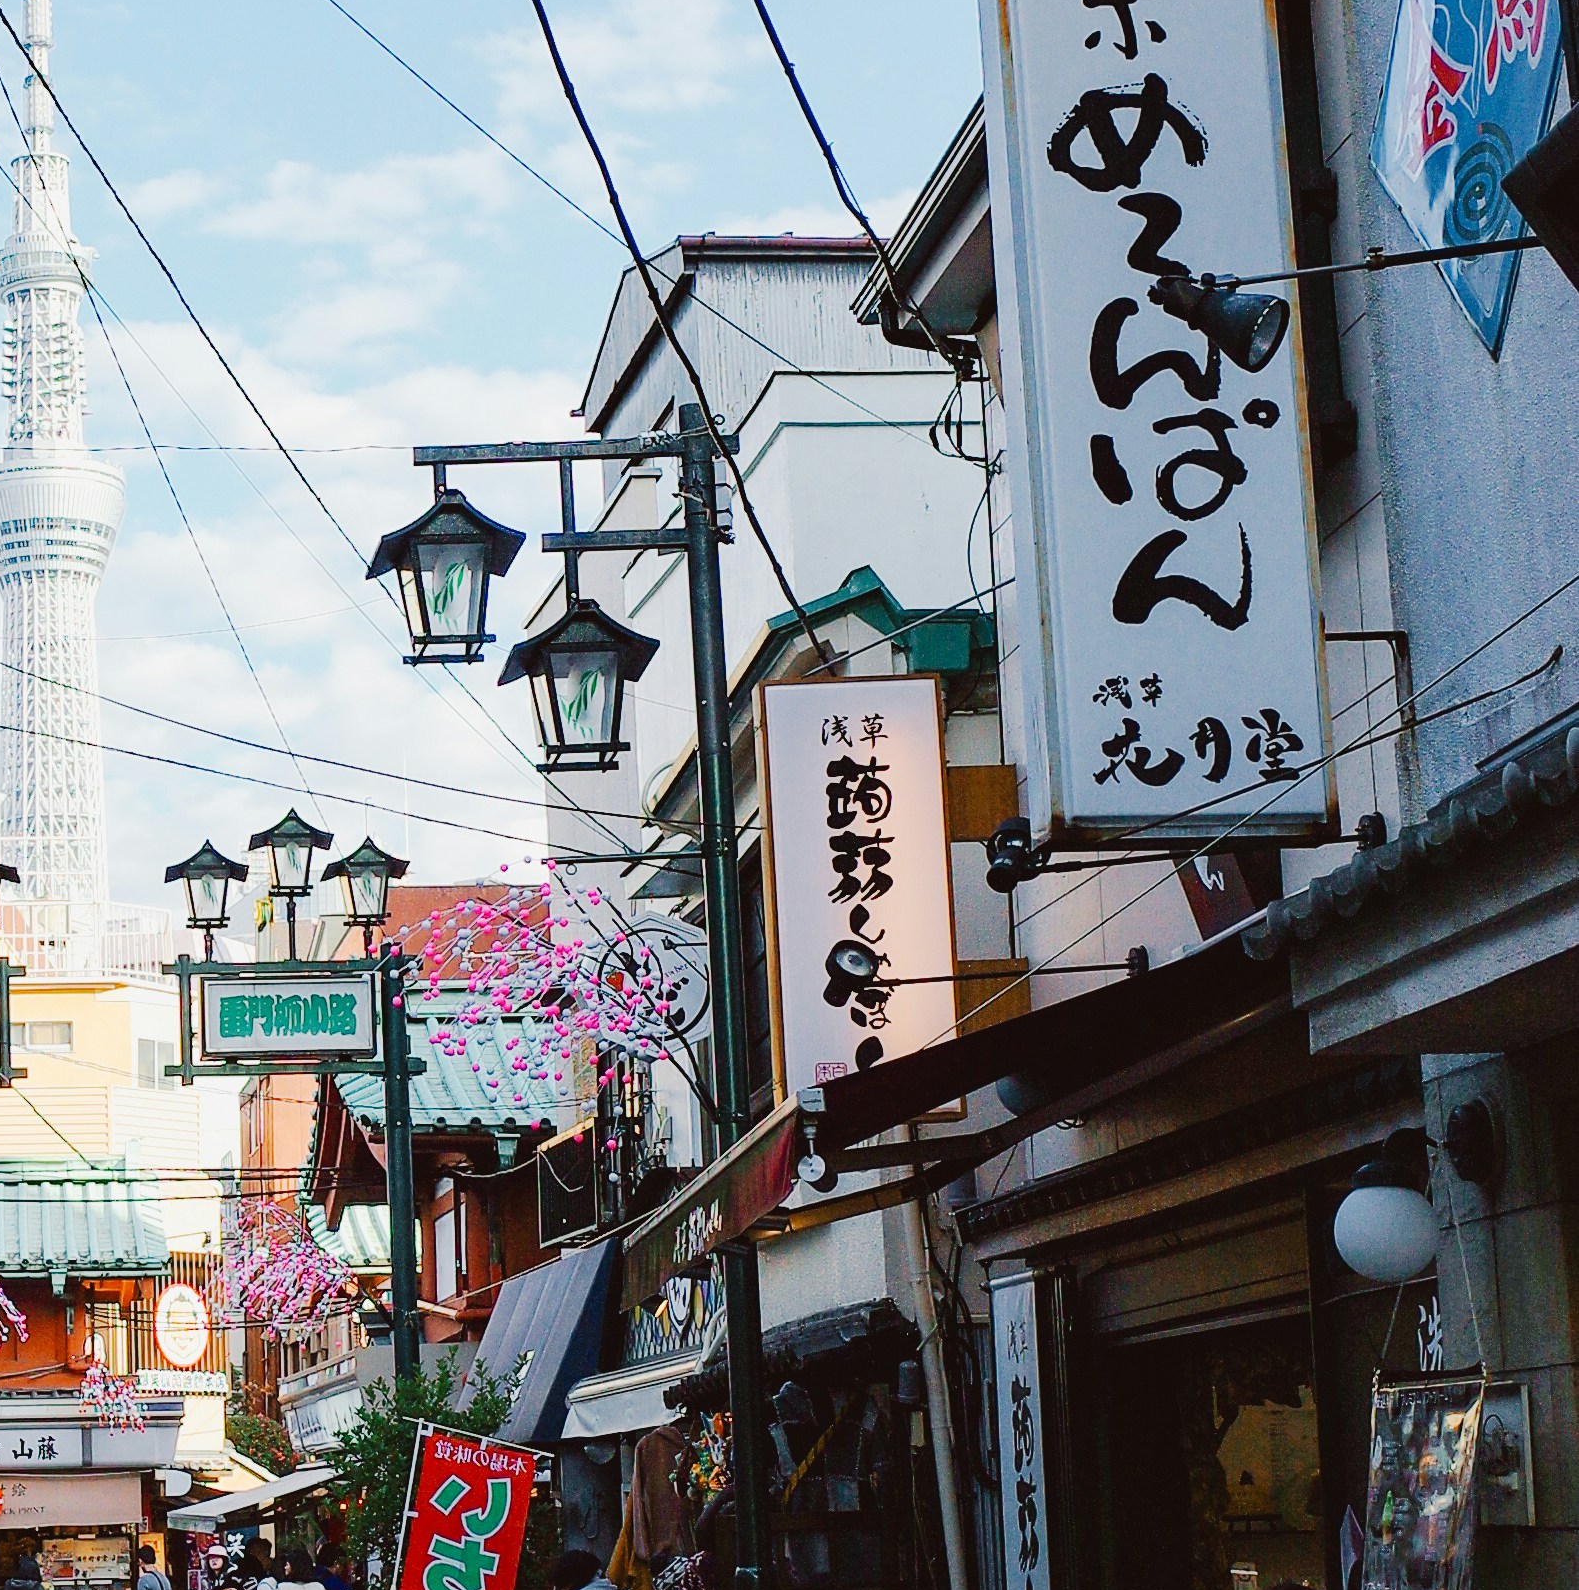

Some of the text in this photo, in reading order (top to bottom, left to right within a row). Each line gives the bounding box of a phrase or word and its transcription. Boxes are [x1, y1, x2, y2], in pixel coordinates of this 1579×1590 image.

[1092, 673, 1162, 709] 浅草
[820, 714, 889, 747] 浅草
[1092, 709, 1305, 786] 花月堂
[11, 1436, 59, 1461] 山藤
